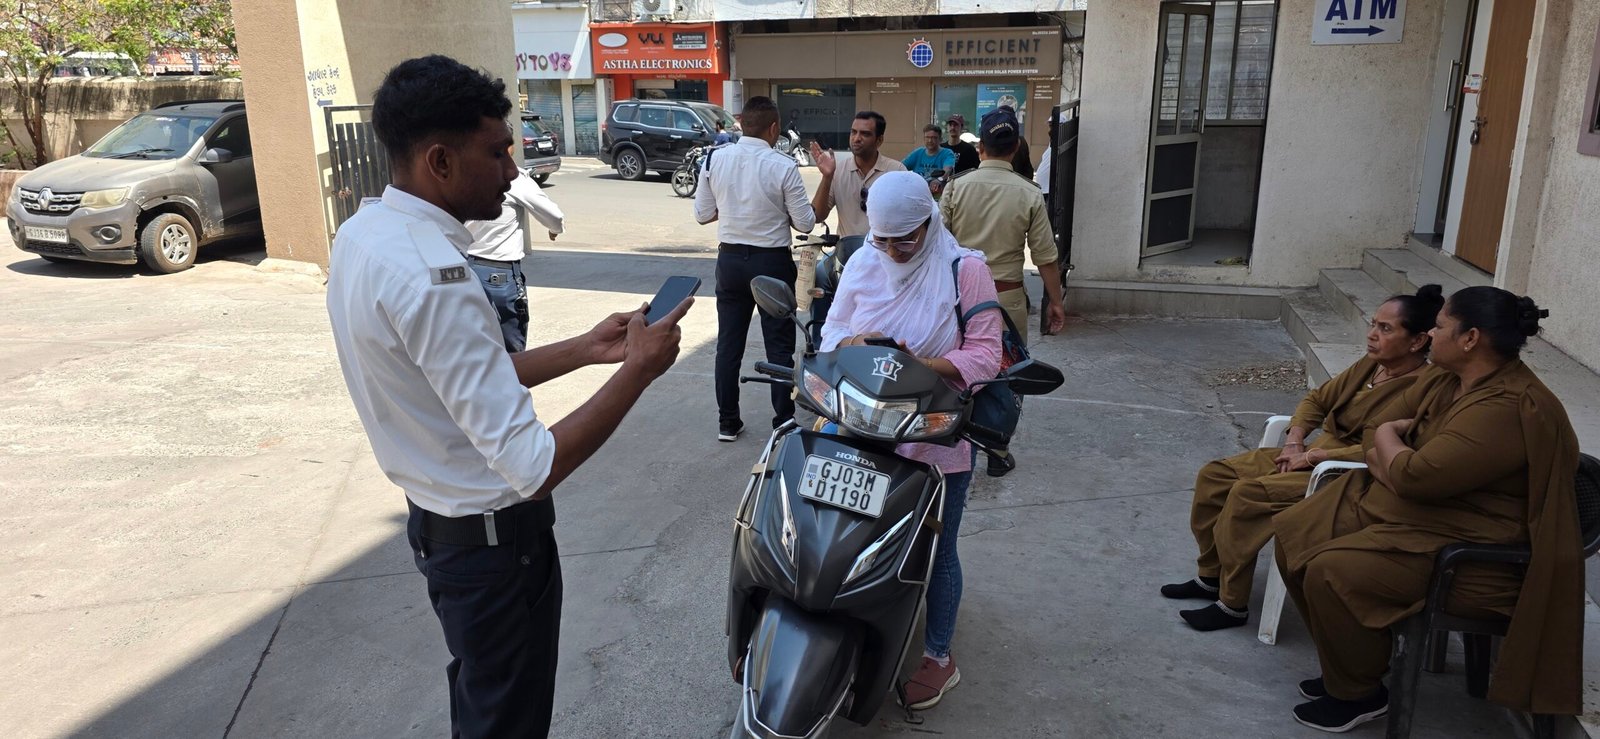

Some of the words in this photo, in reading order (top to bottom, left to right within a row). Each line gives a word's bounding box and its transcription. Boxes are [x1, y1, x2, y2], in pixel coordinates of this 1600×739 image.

[946, 39, 1040, 54] EFFICIENT
[603, 59, 639, 69] ASTHA
[640, 58, 713, 69] ELECTRONICS
[948, 57, 997, 67] ENERTECH
[998, 57, 1018, 66] PVT
[1019, 57, 1037, 66] LTD
[835, 451, 877, 469] HONDA
[820, 461, 877, 492] GJ03M
[814, 479, 871, 511] D1190
